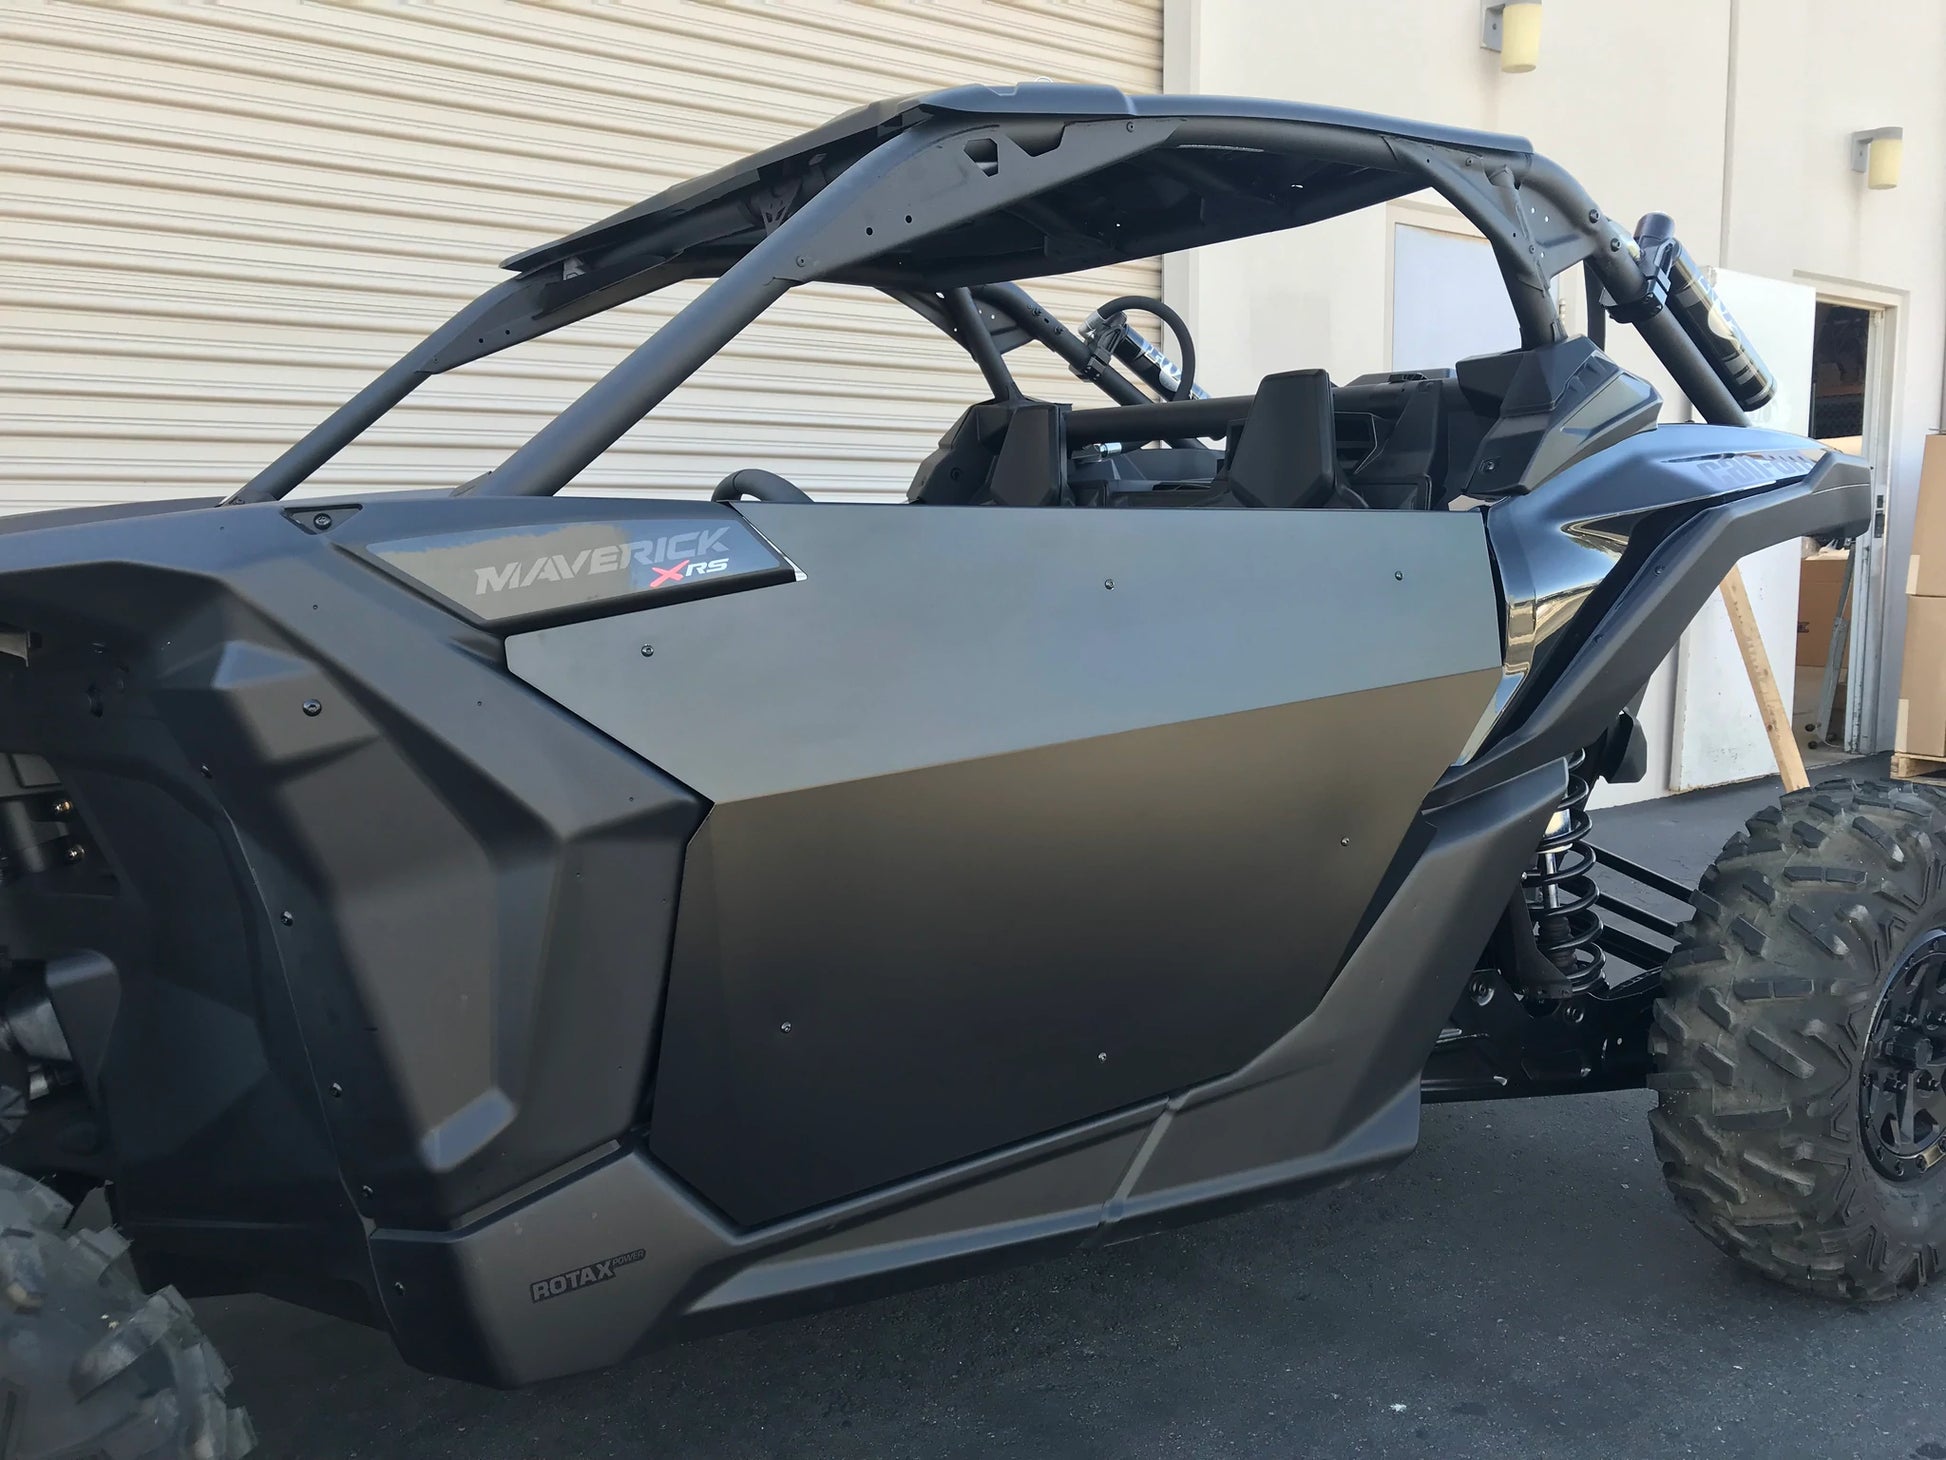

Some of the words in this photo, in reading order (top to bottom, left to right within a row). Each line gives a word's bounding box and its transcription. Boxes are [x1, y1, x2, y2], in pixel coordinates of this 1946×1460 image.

[474, 526, 731, 595] MAVERICK
[532, 1260, 614, 1300] ROTAX
[611, 1249, 645, 1266] POWER
